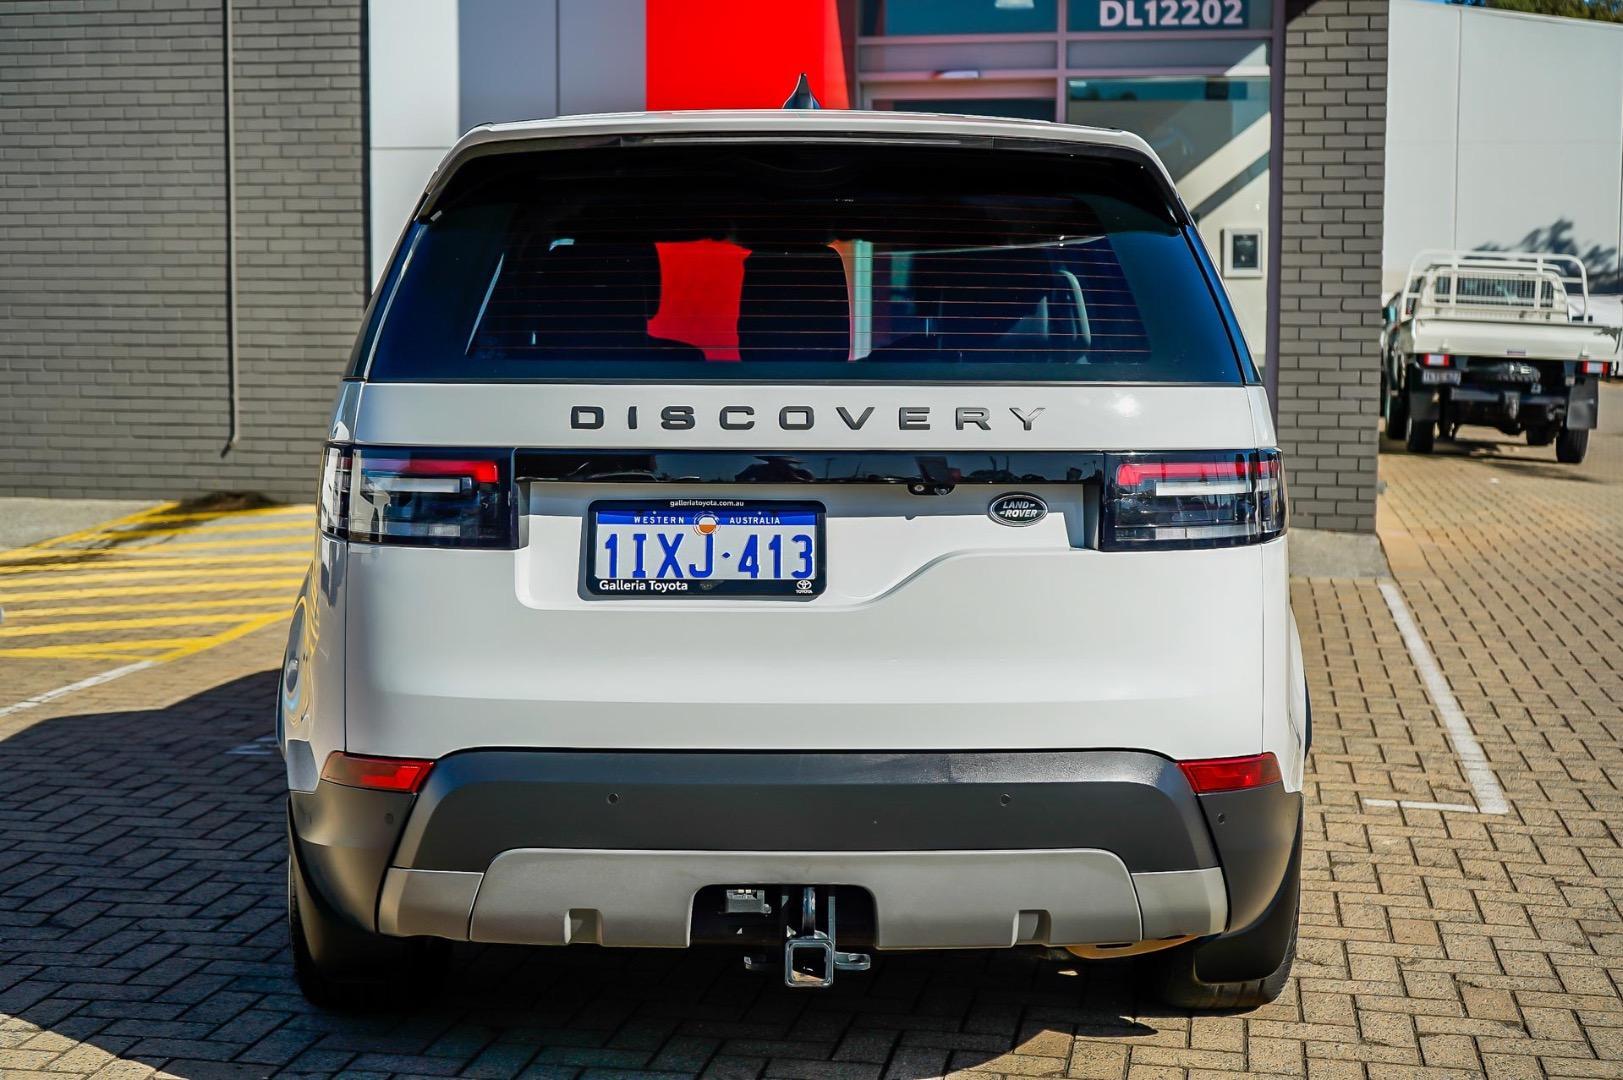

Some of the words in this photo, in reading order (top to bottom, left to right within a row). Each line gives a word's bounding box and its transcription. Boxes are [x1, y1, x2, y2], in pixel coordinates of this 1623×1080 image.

[1100, 0, 1243, 27] DL12202
[570, 405, 1046, 431] DISCOVERY
[669, 500, 745, 508] galleriatoyota.com.au
[633, 516, 684, 524] WESTERN
[729, 516, 781, 525] AUSTRALIA
[599, 580, 646, 591] Galleria
[648, 580, 689, 593] Toyota
